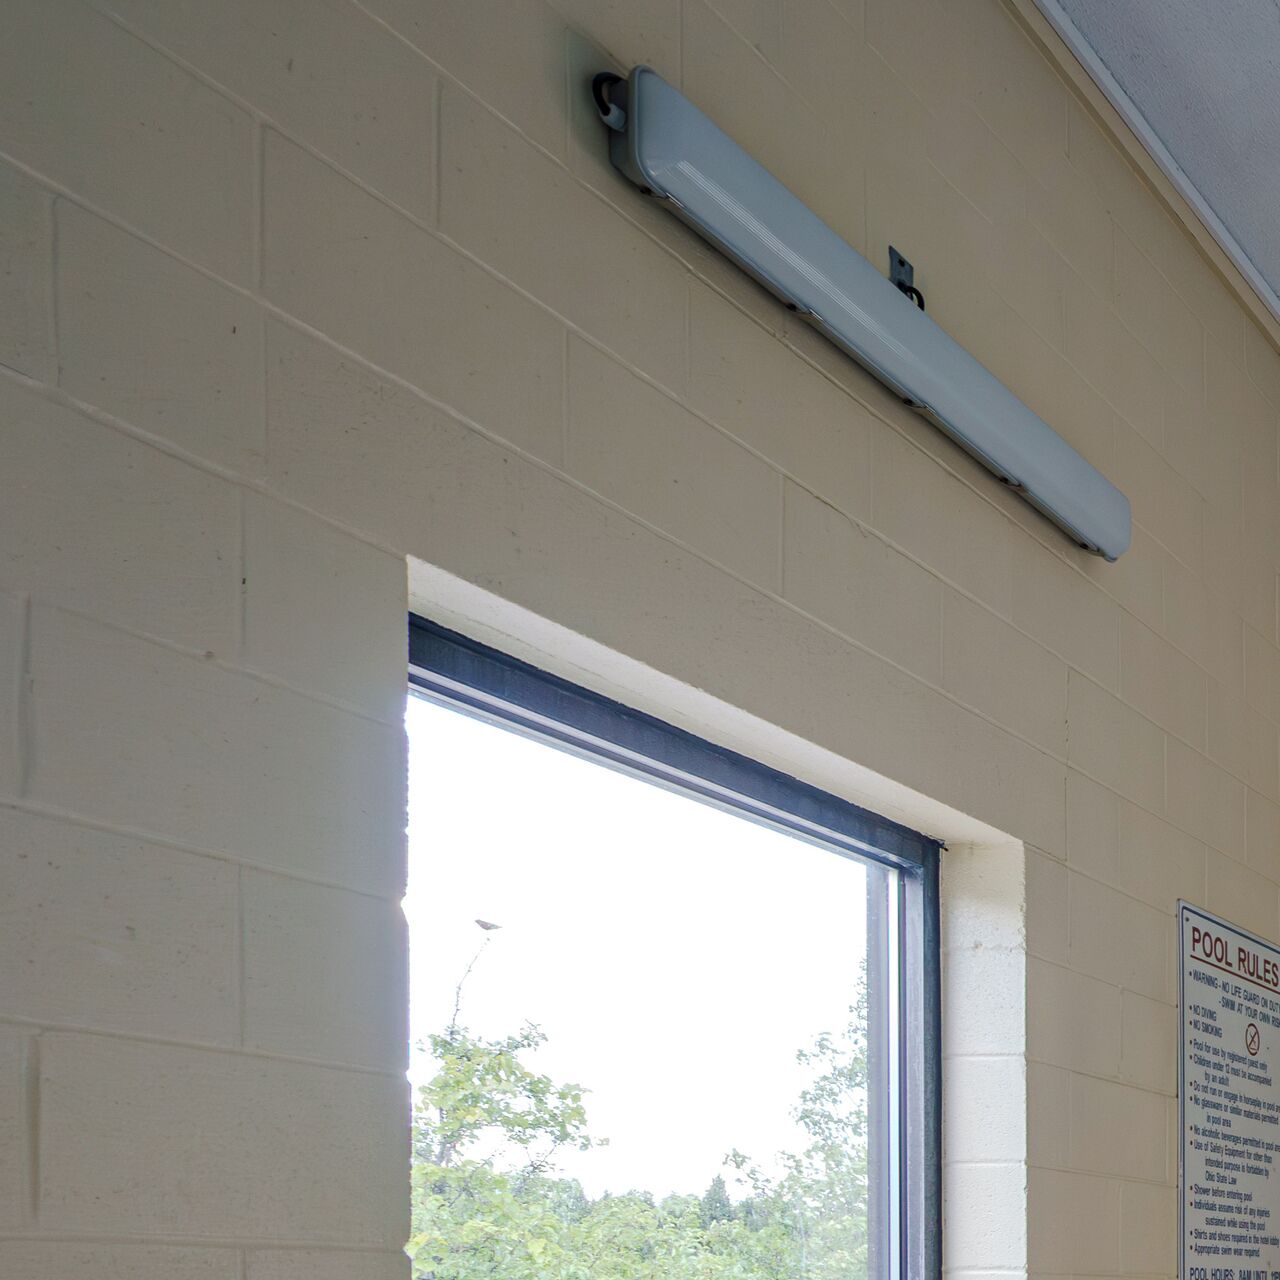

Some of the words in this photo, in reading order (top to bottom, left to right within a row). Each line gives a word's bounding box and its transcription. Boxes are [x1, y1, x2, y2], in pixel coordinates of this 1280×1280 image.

[1192, 926, 1232, 967] POOL
[1238, 947, 1278, 988] RULES
[1222, 981, 1229, 993] NO
[1231, 985, 1241, 998] LIFE
[1243, 990, 1260, 1005] GUARD
[1261, 997, 1268, 1008] ON
[1269, 1000, 1280, 1013] DUTY
[1193, 1004, 1200, 1016] NO
[1202, 1007, 1216, 1022] DIVING
[1237, 1003, 1244, 1014] AT
[1245, 1006, 1258, 1019] YOUR
[1259, 1011, 1270, 1024] OWN
[1193, 1019, 1200, 1031] NO
[1202, 1022, 1222, 1038] SMOKING
[1194, 1039, 1203, 1051] Pool
[1212, 1047, 1220, 1057] use
[1227, 1051, 1247, 1065] registered
[1194, 1054, 1211, 1068] Children
[1213, 1061, 1223, 1071] under
[1231, 1067, 1240, 1077] must
[1248, 1072, 1271, 1086] accompanied
[1219, 1075, 1229, 1086] adult
[1224, 1092, 1238, 1104] engage
[1267, 1101, 1275, 1112] pool
[1202, 1098, 1223, 1112] glassware
[1243, 1110, 1260, 1120] materials
[1262, 1114, 1278, 1126] permitted
[1212, 1115, 1221, 1127] pool
[1222, 1119, 1231, 1128] area
[1202, 1127, 1220, 1139] alcoholic
[1221, 1131, 1241, 1144] beverages
[1243, 1136, 1260, 1148] permitted
[1194, 1140, 1203, 1150] Use
[1210, 1143, 1223, 1156] Safety
[1253, 1152, 1263, 1162] other
[1264, 1154, 1272, 1163] than
[1205, 1156, 1223, 1168] intended
[1224, 1161, 1240, 1173] purpose
[1205, 1171, 1215, 1181] Ohio
[1217, 1173, 1227, 1183] State
[1228, 1175, 1237, 1185] Law
[1194, 1184, 1210, 1195] Shower
[1212, 1188, 1225, 1197] before
[1227, 1190, 1243, 1202] entering
[1244, 1192, 1252, 1202] pool
[1194, 1198, 1217, 1211] Individuals
[1218, 1205, 1234, 1213] assume
[1205, 1216, 1226, 1227] sustained
[1227, 1218, 1237, 1227] while
[1239, 1221, 1249, 1231] using
[1257, 1222, 1265, 1232] pool
[1194, 1229, 1207, 1240] Shirts
[1218, 1232, 1230, 1241] shoes
[1194, 1244, 1220, 1256] Appropriate
[1244, 1248, 1259, 1259] required
[1190, 1268, 1209, 1280] POOL
